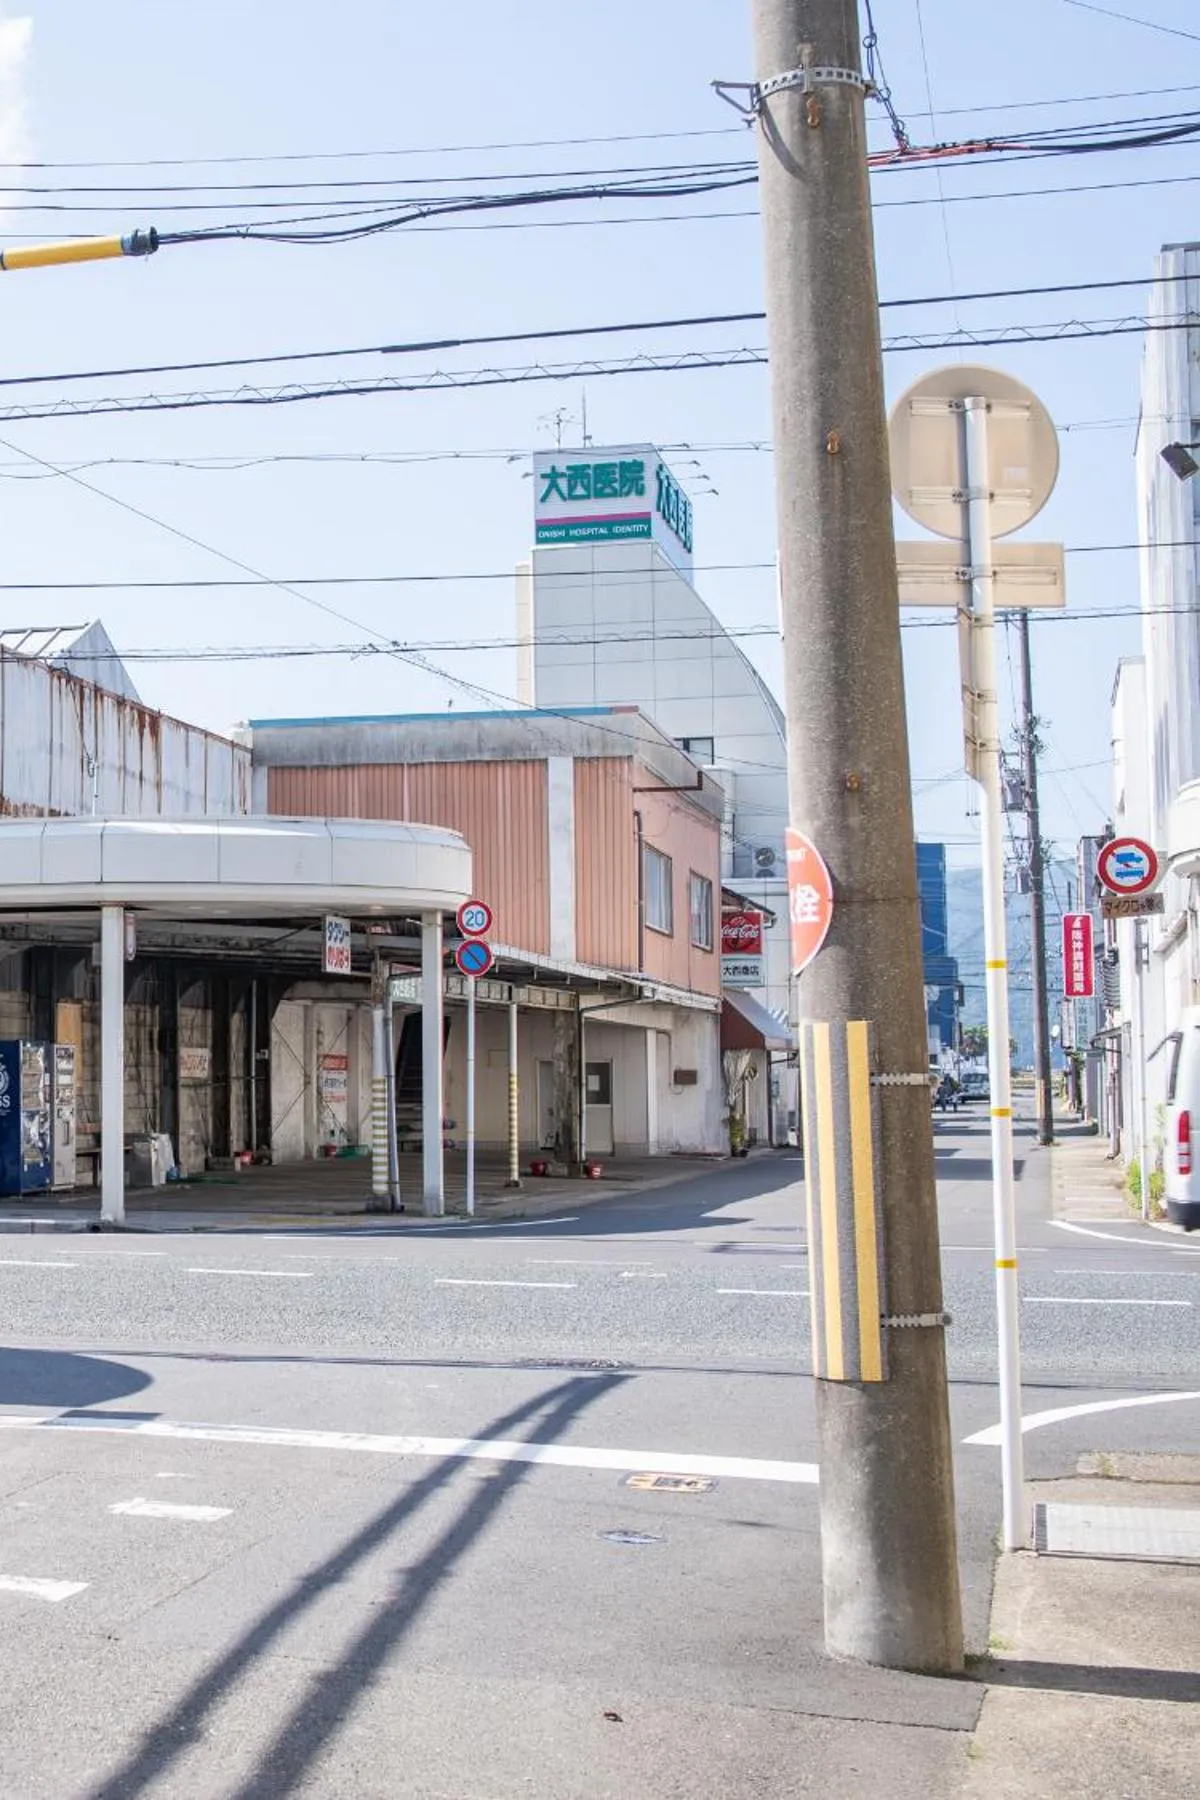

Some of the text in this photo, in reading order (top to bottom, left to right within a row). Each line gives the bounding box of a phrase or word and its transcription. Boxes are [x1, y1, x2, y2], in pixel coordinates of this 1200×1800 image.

[540, 459, 645, 502] 大西医院
[538, 523, 649, 539] ONISHI HOSPITAL IDENTITY
[464, 909, 485, 928] 20
